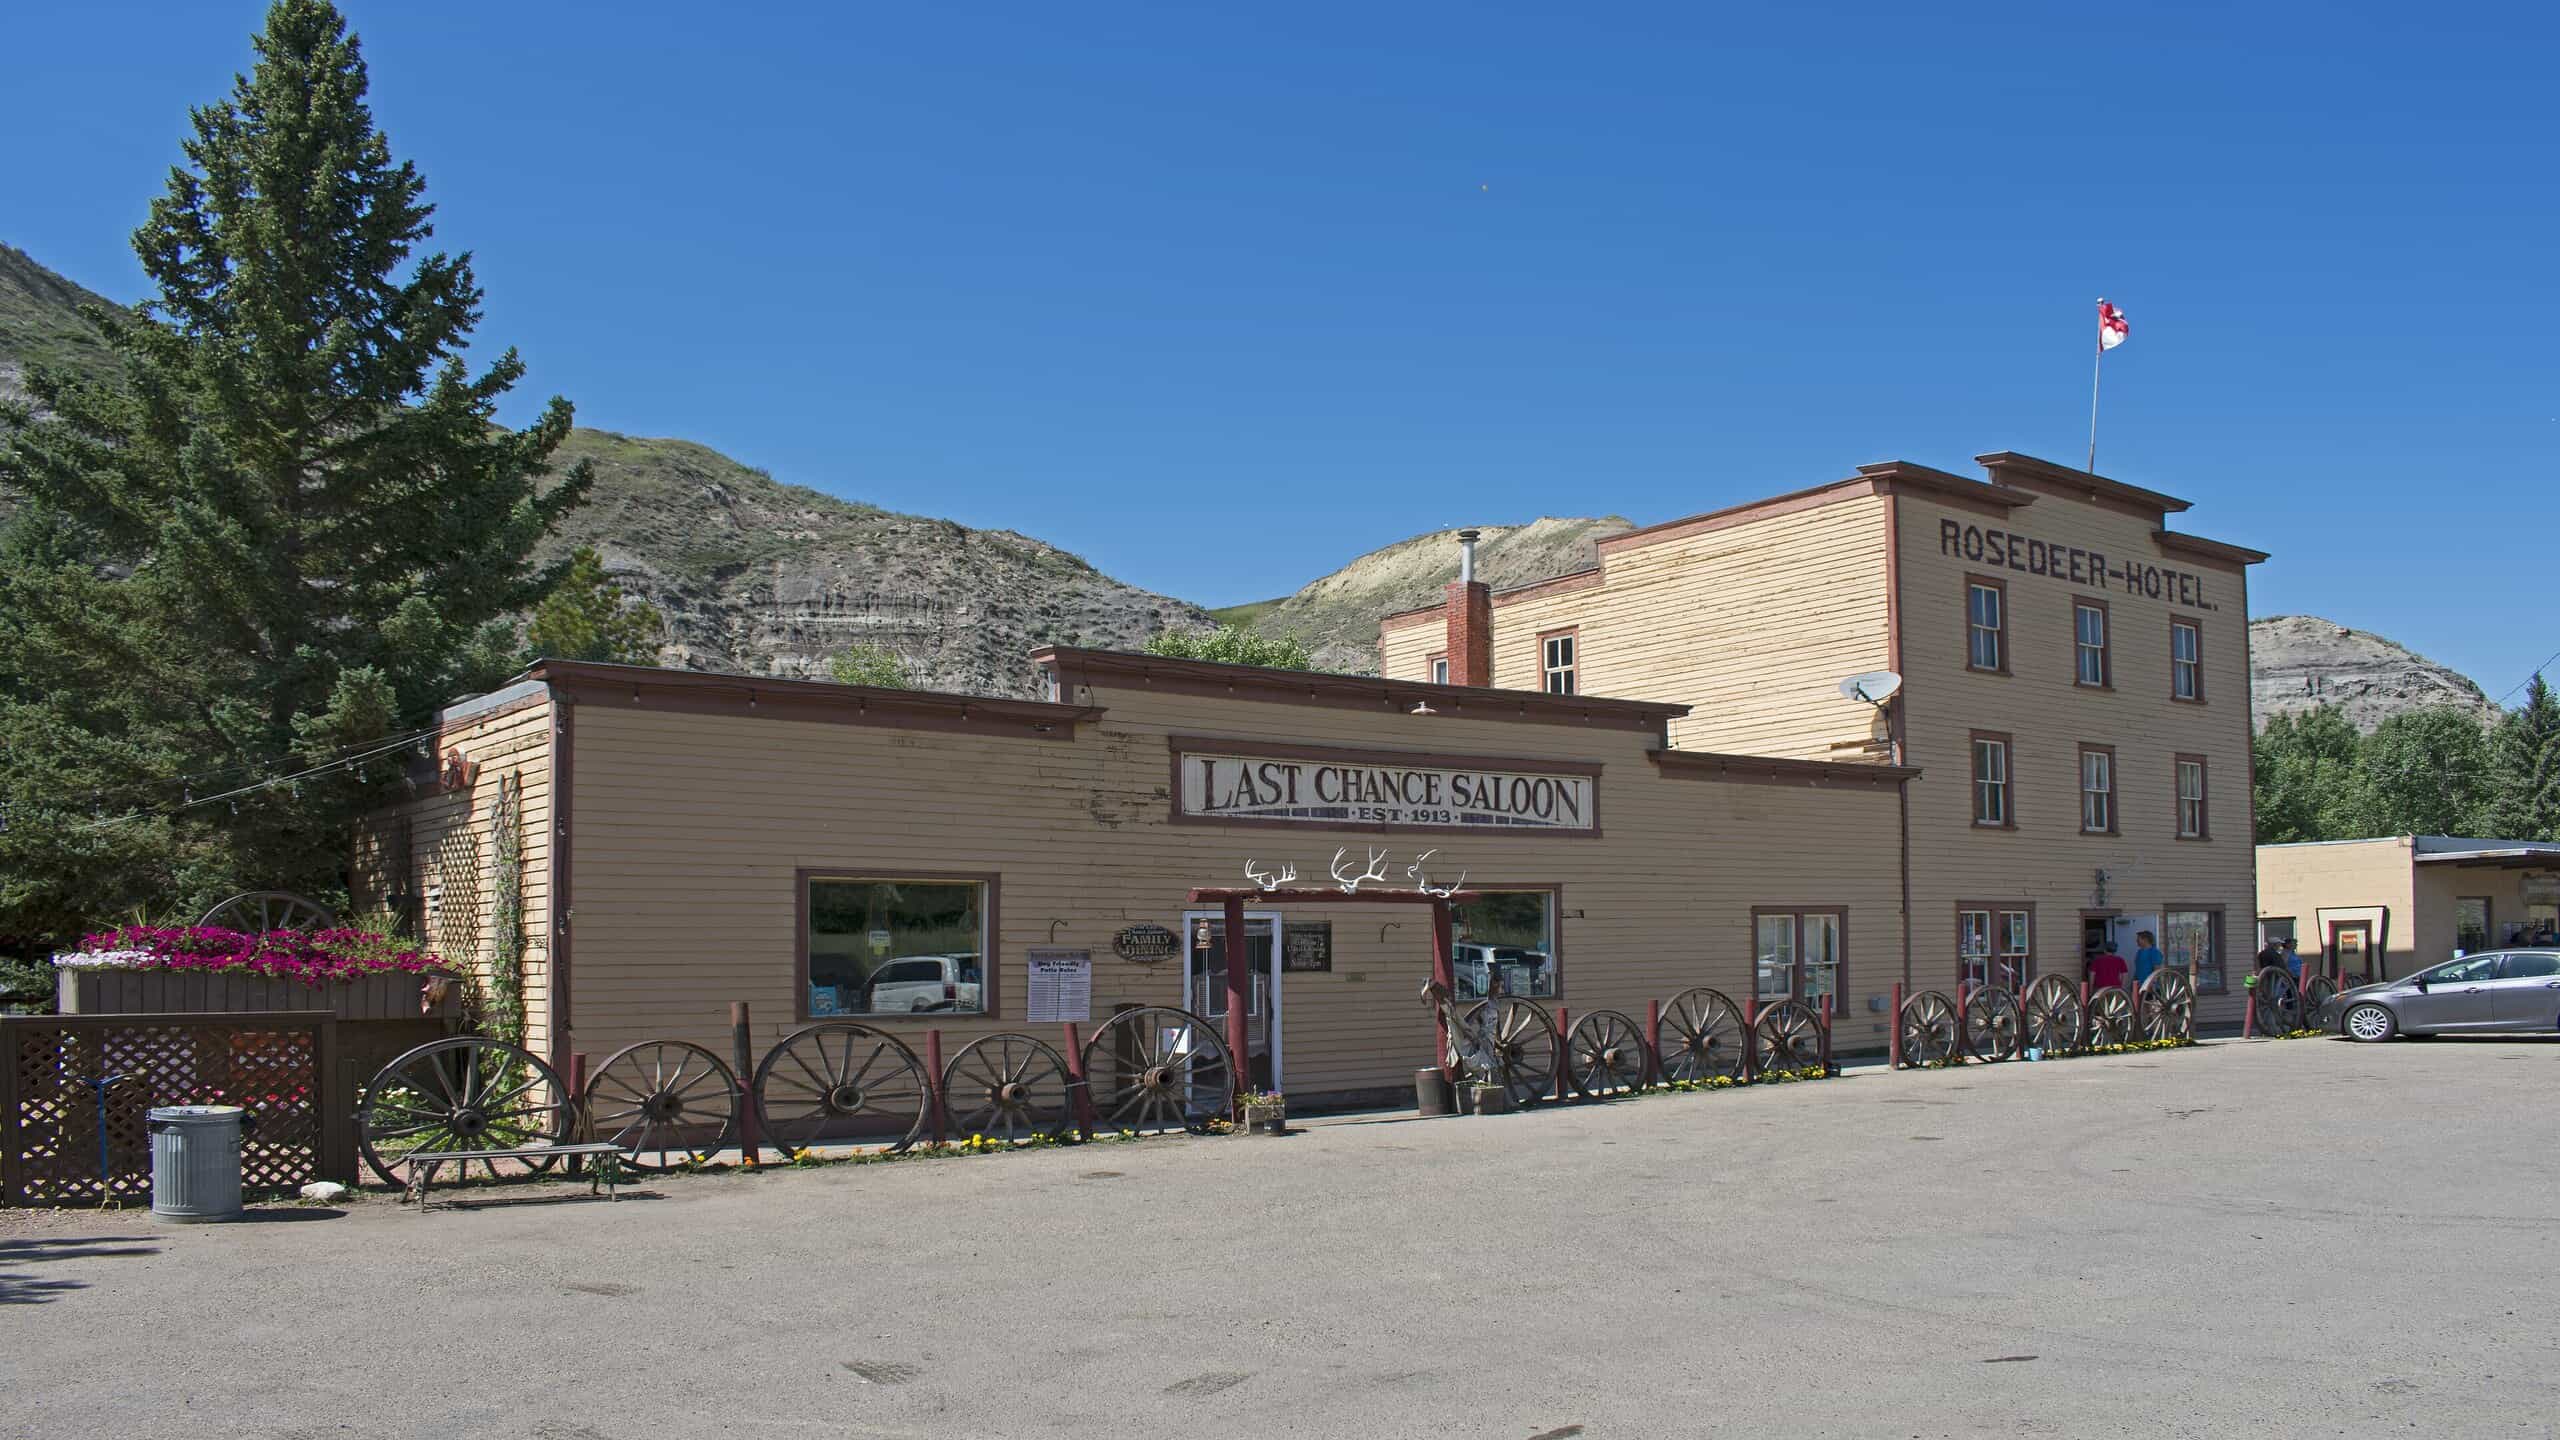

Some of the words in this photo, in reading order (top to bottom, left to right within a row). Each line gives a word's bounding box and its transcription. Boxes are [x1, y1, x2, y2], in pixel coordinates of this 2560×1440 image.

[1201, 760, 1302, 811] LAST
[1314, 767, 1442, 806] CHANCE
[1450, 774, 1581, 824] SALOON
[1121, 934, 1171, 945] FAMILY
